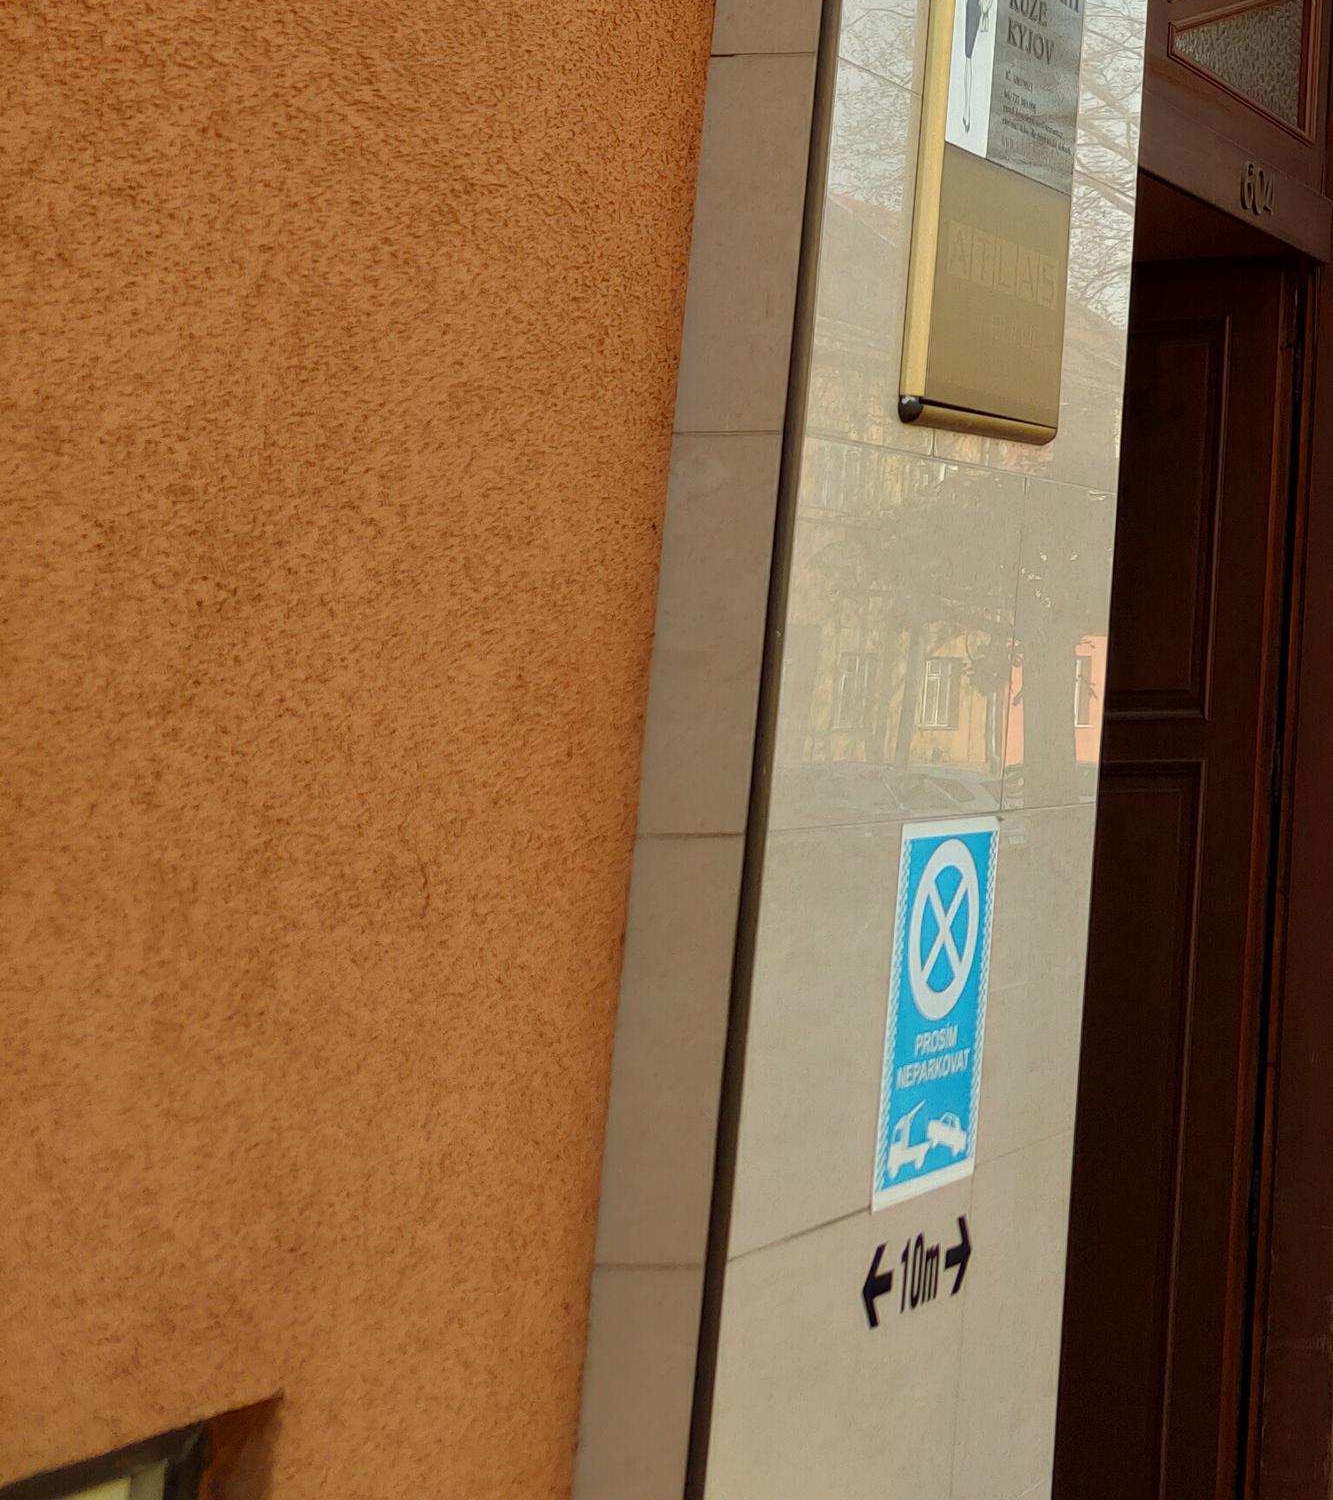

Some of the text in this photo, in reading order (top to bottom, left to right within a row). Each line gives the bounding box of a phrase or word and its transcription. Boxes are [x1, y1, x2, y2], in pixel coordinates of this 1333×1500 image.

[1006, 16, 1055, 66] KYJOV
[946, 229, 1058, 305] ATLAS
[914, 1021, 959, 1060] PROSÍM
[896, 1048, 971, 1091] NEPARKOVAT
[900, 1231, 940, 1314] 10m
